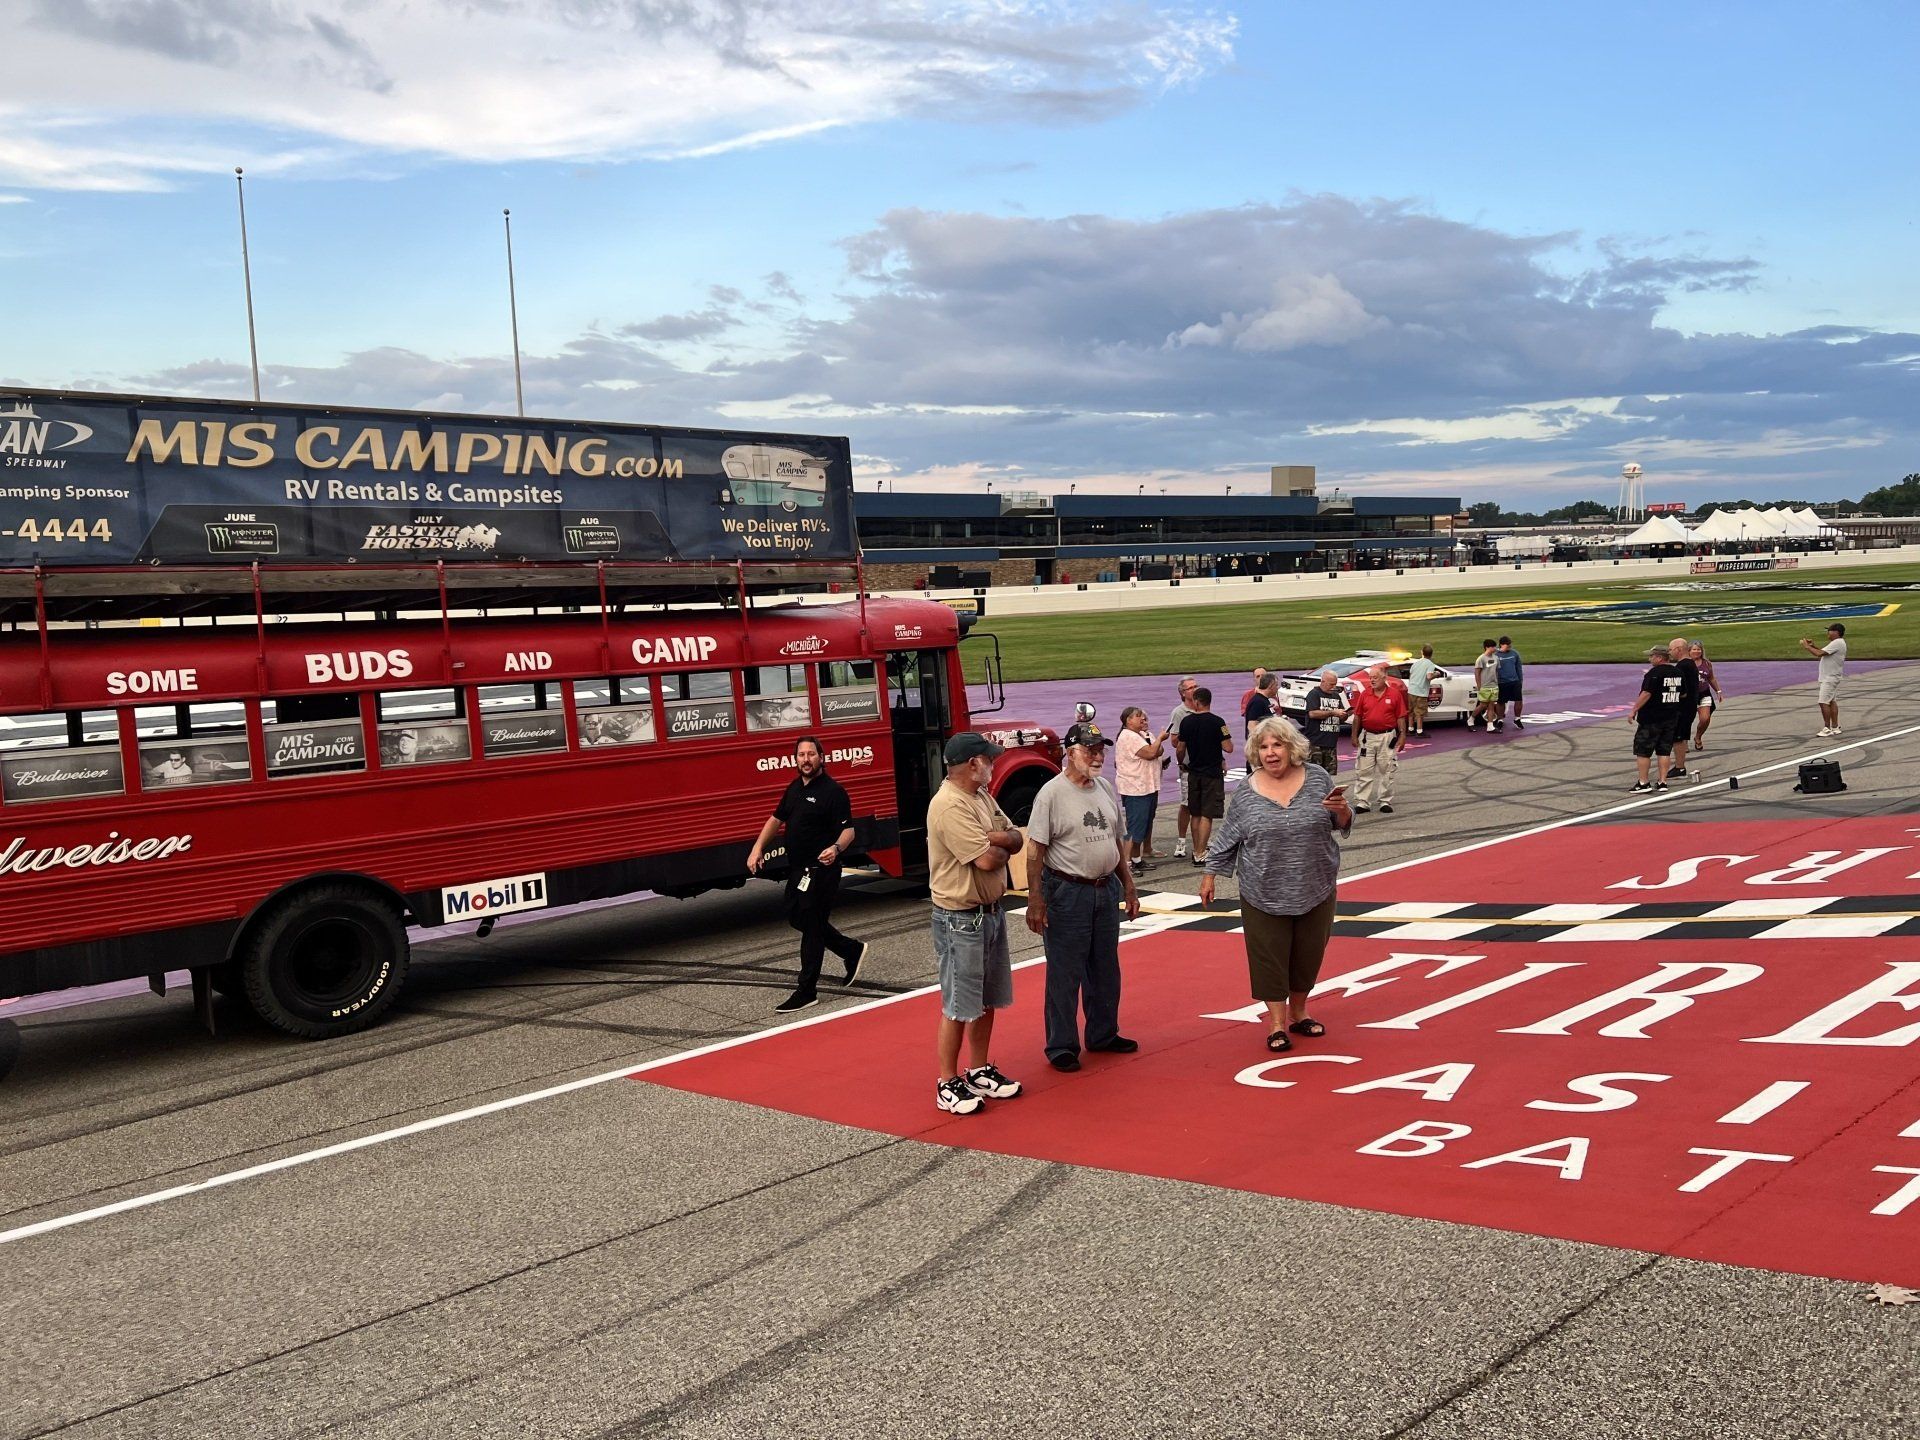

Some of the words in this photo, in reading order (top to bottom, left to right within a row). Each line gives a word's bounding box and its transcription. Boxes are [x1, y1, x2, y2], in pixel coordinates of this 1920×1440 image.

[0, 420, 53, 455] AN
[126, 418, 277, 468] MIS
[5, 457, 67, 469] SPEEDWAY
[65, 485, 130, 500] Sponsor
[284, 479, 320, 501] RV
[328, 479, 420, 502] Rentals
[425, 483, 443, 501] &
[447, 483, 563, 507] Campsites
[223, 513, 257, 522] JUNE
[414, 515, 444, 524] JULY
[580, 517, 600, 525] AUG
[721, 518, 744, 533] We
[747, 518, 798, 533] Deliver
[801, 518, 831, 533] RV's.
[231, 529, 275, 537] MONSTER
[366, 525, 460, 538] FASTER
[360, 537, 456, 550] HORSES
[743, 534, 771, 548] You
[774, 534, 814, 551] Enjoy.
[895, 630, 922, 638] CAMPING
[786, 639, 821, 652] MICHIGAN
[106, 668, 198, 695] SOME
[304, 649, 413, 684] BUDS
[503, 651, 553, 672] AND
[631, 636, 718, 664] CAMP
[824, 699, 874, 712] Budweiser
[674, 709, 700, 722] MIS
[672, 717, 729, 733] CAMPING
[279, 733, 314, 749] MIS
[489, 727, 557, 743] Budweiser
[274, 742, 356, 762] CAMPING
[831, 746, 873, 763] BUDS
[12, 767, 109, 787] Budweiser
[1604, 828, 1920, 890] RS
[446, 883, 517, 915] Mobil
[526, 880, 539, 901] 1
[332, 961, 390, 1017] GOODYEAR
[1233, 1054, 1920, 1138] CASI
